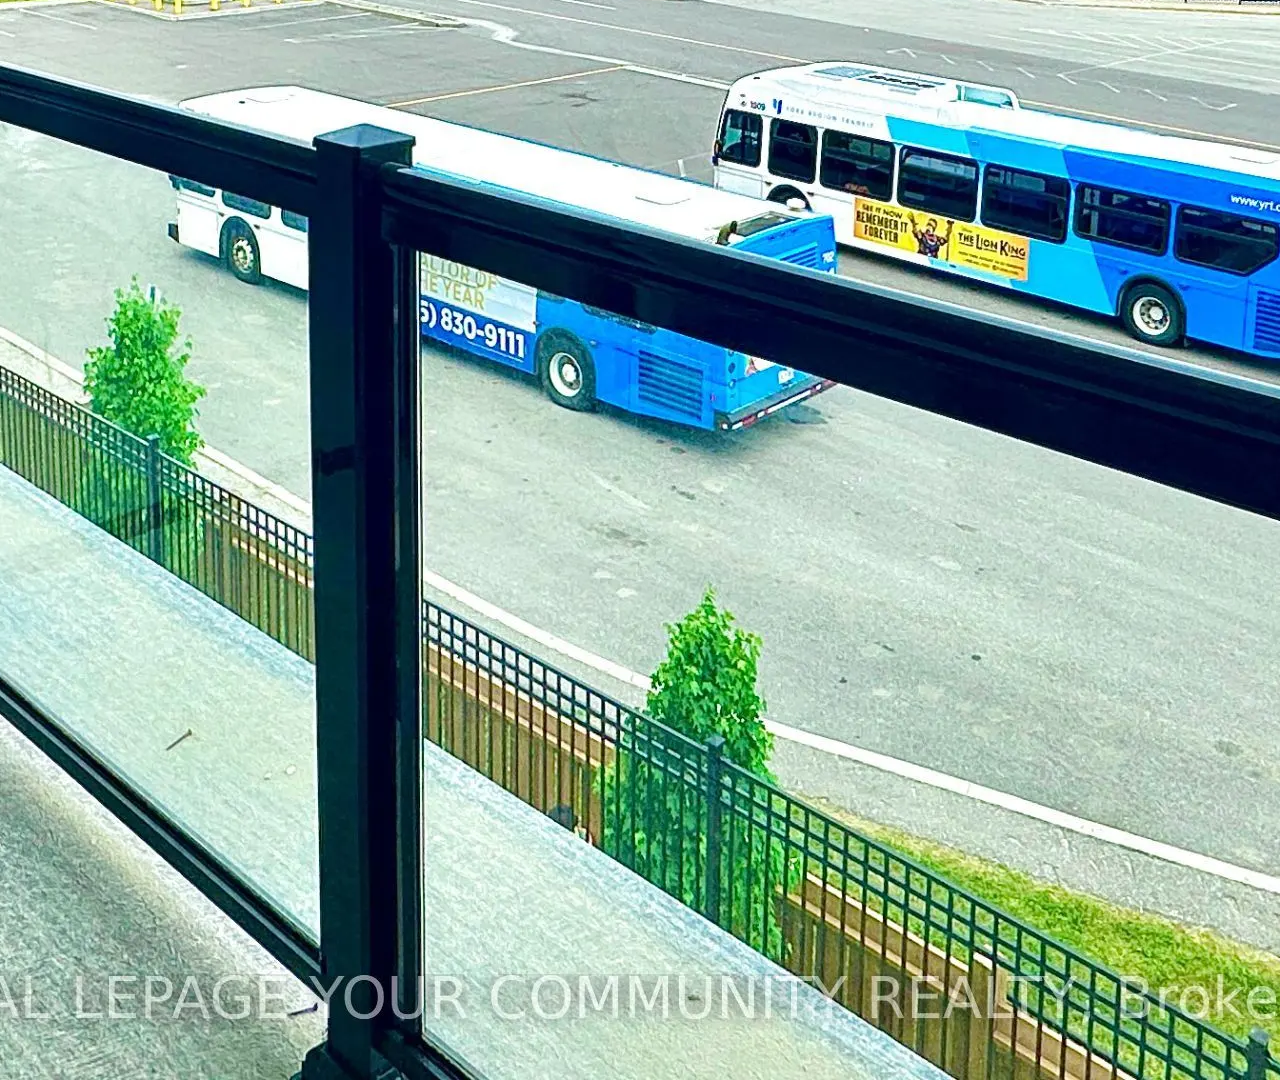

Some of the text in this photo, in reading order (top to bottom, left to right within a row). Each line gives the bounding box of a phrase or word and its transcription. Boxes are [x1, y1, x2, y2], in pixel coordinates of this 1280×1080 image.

[856, 210, 908, 233] REMEMBER IT
[883, 209, 904, 219] NOW
[864, 224, 899, 243] FOREVER
[958, 232, 1026, 258] THE LION KING
[475, 270, 497, 290] OF
[442, 277, 485, 311] YEAR
[440, 307, 525, 359] 830-9111
